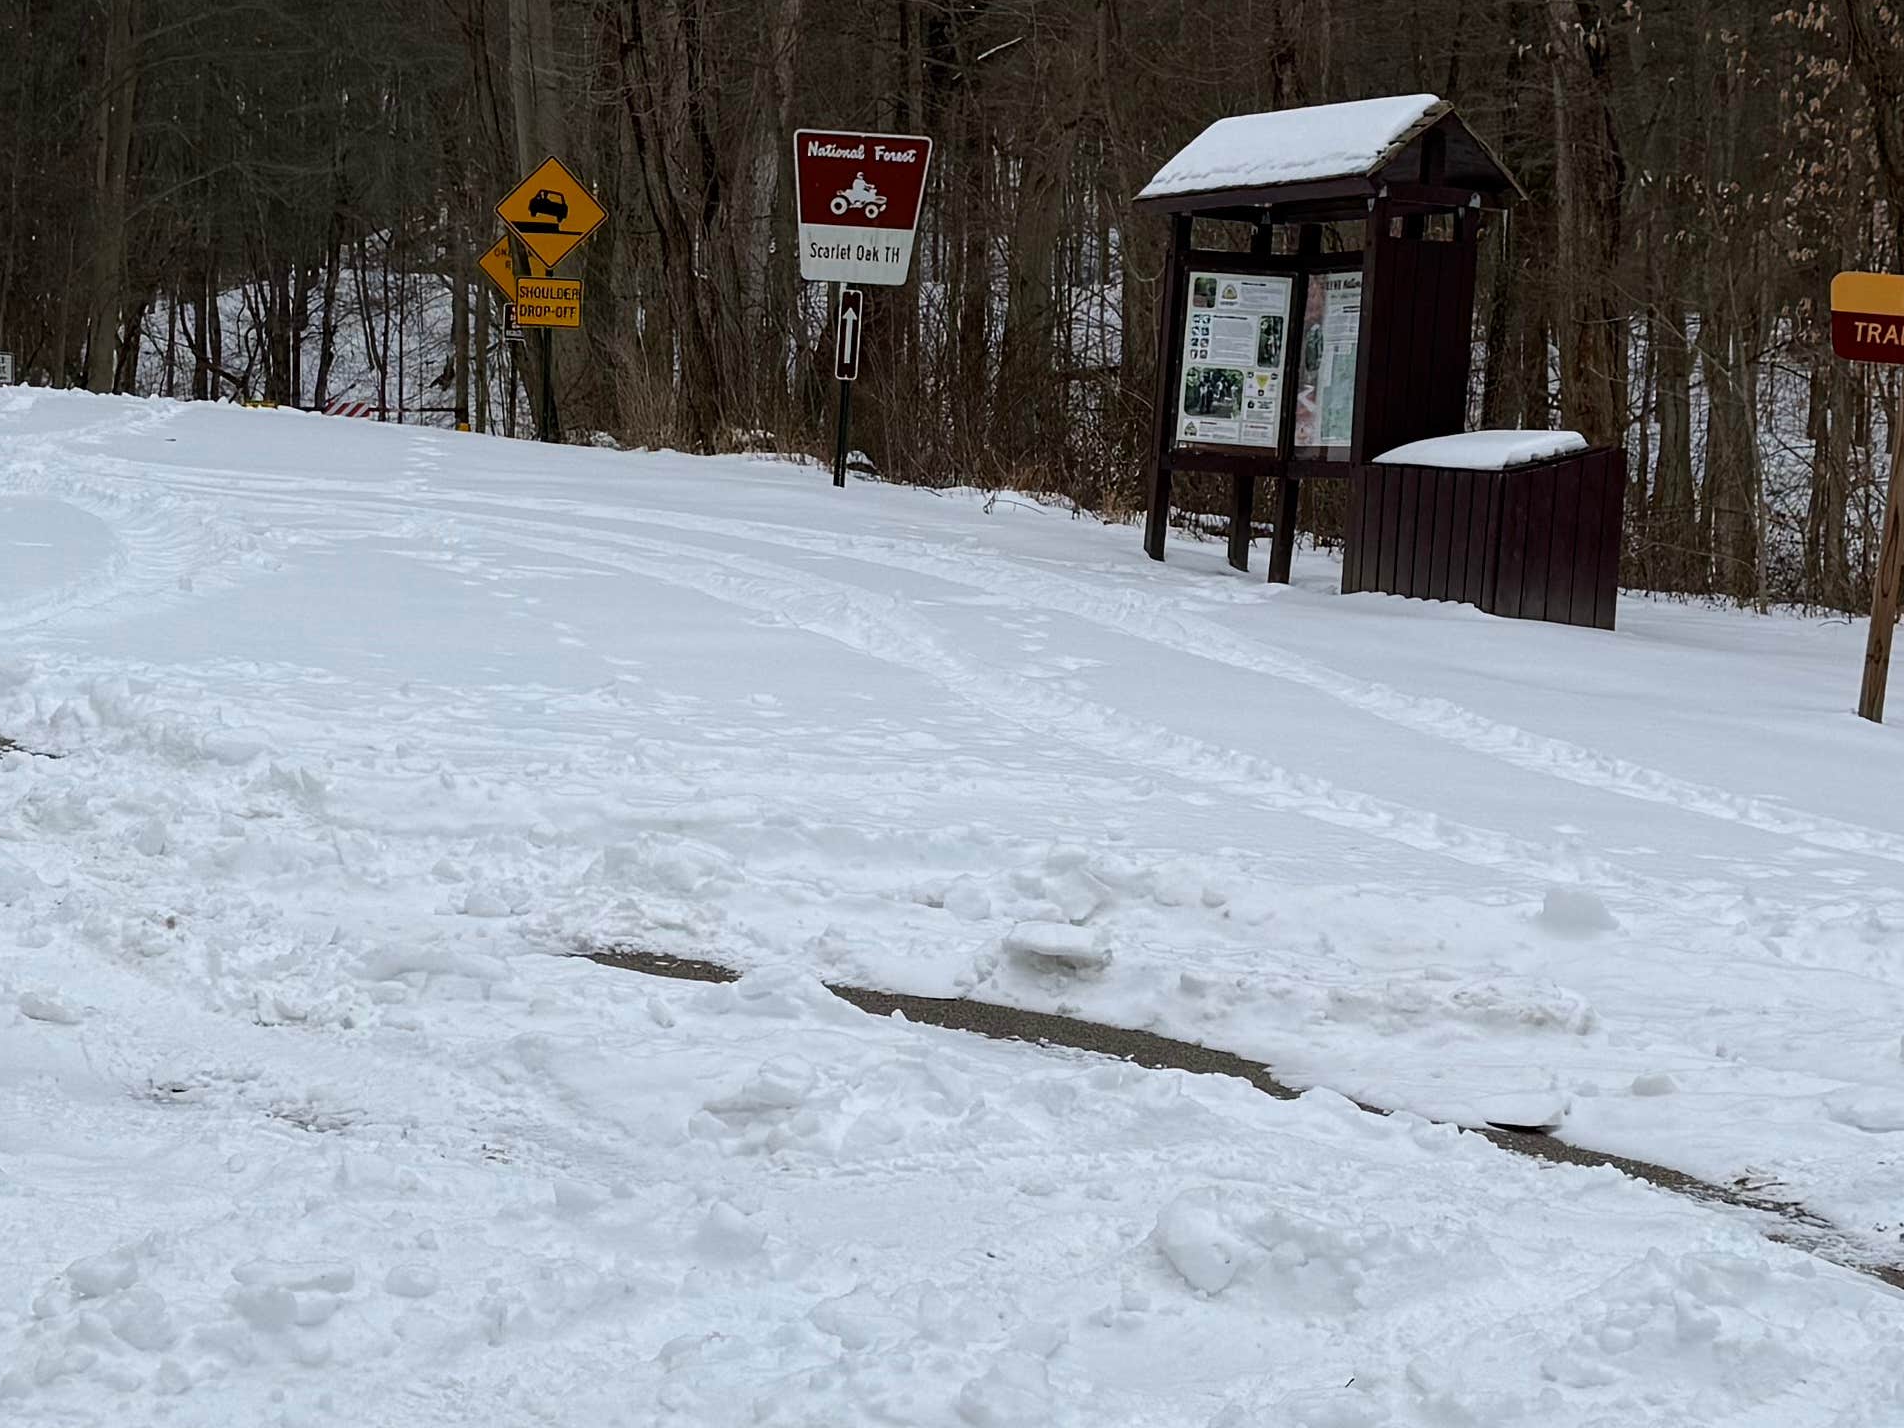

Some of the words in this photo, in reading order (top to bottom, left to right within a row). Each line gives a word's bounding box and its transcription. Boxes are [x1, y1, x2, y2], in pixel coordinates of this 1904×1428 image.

[807, 141, 865, 160] National
[874, 146, 917, 163] Forest
[810, 242, 851, 260] Scarlet
[856, 245, 879, 262] Oak
[885, 247, 900, 263] TH
[519, 286, 579, 300] SHOULDER
[519, 305, 576, 318] DROP-OFF
